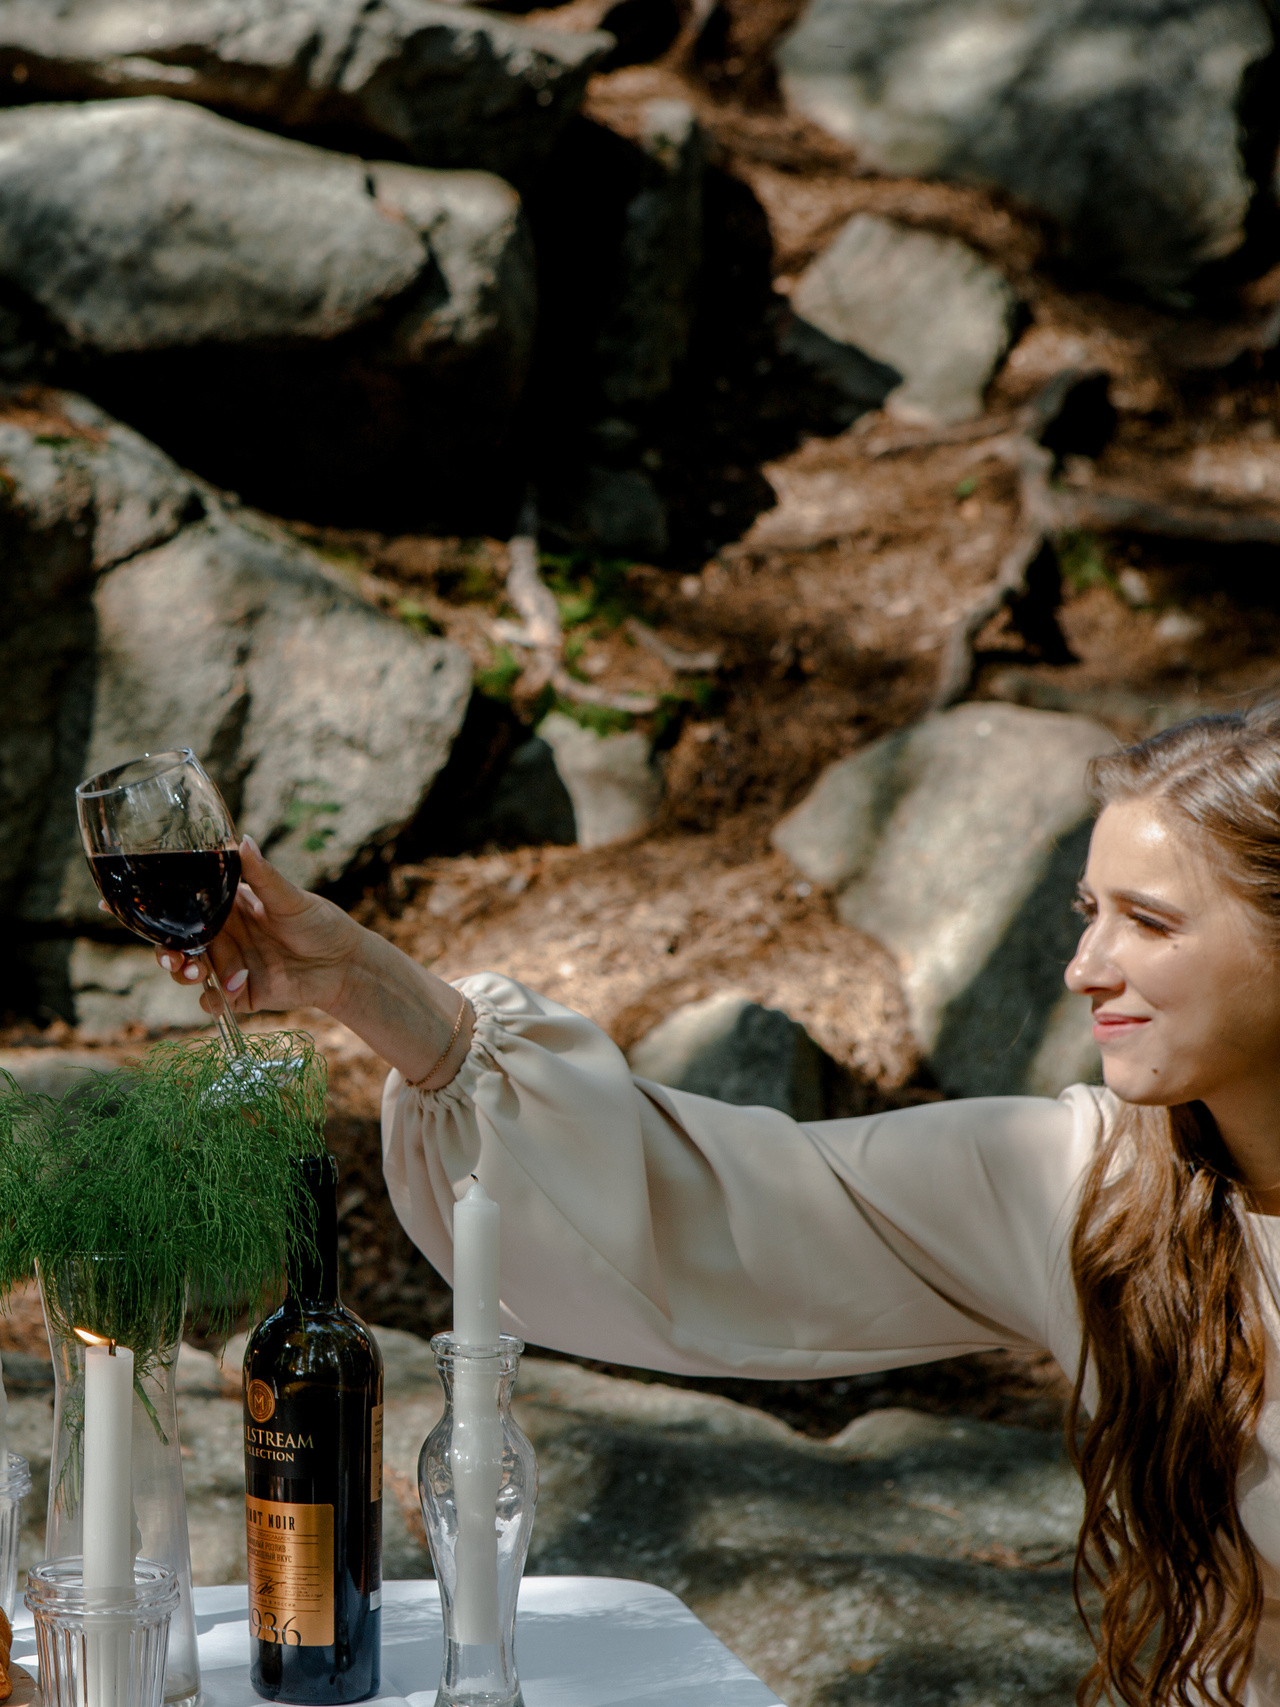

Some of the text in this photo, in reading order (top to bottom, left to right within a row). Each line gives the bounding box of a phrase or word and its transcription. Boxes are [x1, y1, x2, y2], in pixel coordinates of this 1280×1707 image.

[253, 1394, 265, 1411] M
[268, 1514, 296, 1531] NOIR
[276, 1553, 293, 1564] ВКУС
